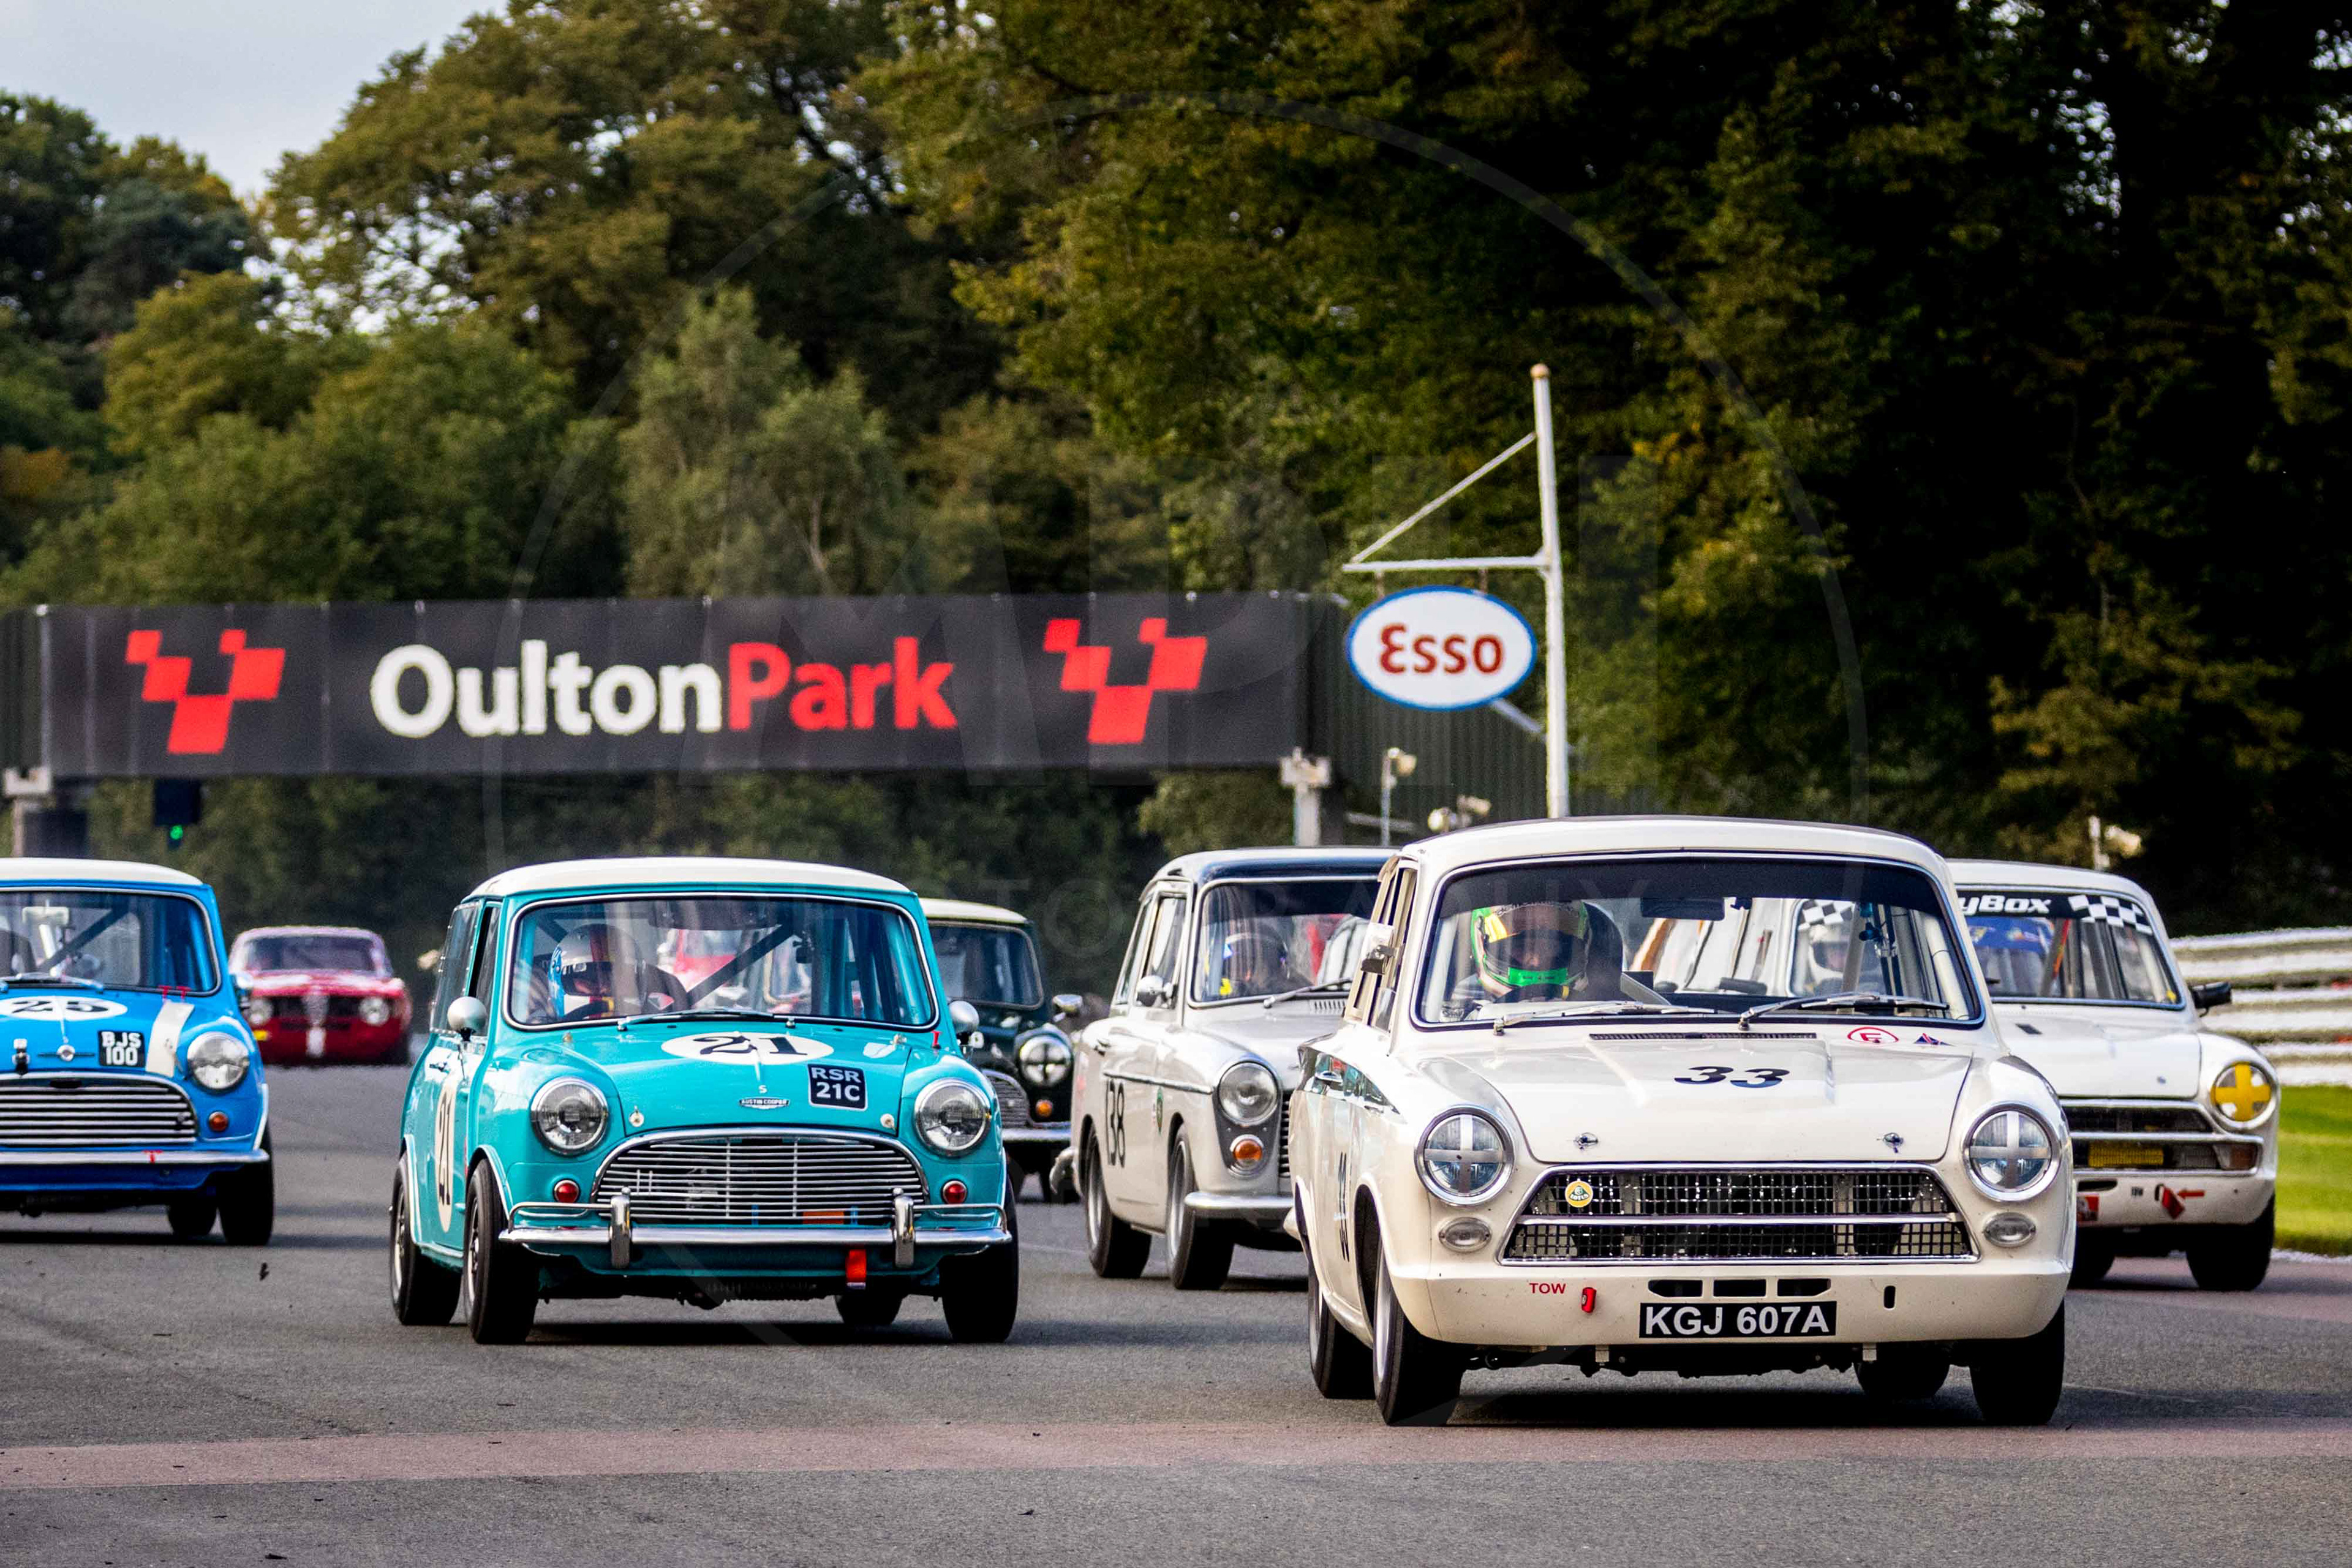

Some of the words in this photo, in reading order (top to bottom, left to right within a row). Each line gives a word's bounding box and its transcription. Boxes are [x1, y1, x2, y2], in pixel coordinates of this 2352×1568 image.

[1379, 622, 1505, 674] Esso
[12, 1000, 109, 1014] 25
[101, 1031, 141, 1049] BJS
[693, 1035, 808, 1056] 21
[107, 1046, 139, 1066] 100
[811, 1066, 862, 1083] RSR
[1674, 1065, 1790, 1088] 33
[758, 1084, 768, 1094] S
[816, 1082, 861, 1102] 21C
[1529, 1283, 1566, 1294] TOW
[1645, 1306, 1724, 1335] KGJ
[1736, 1305, 1830, 1335] 607A
